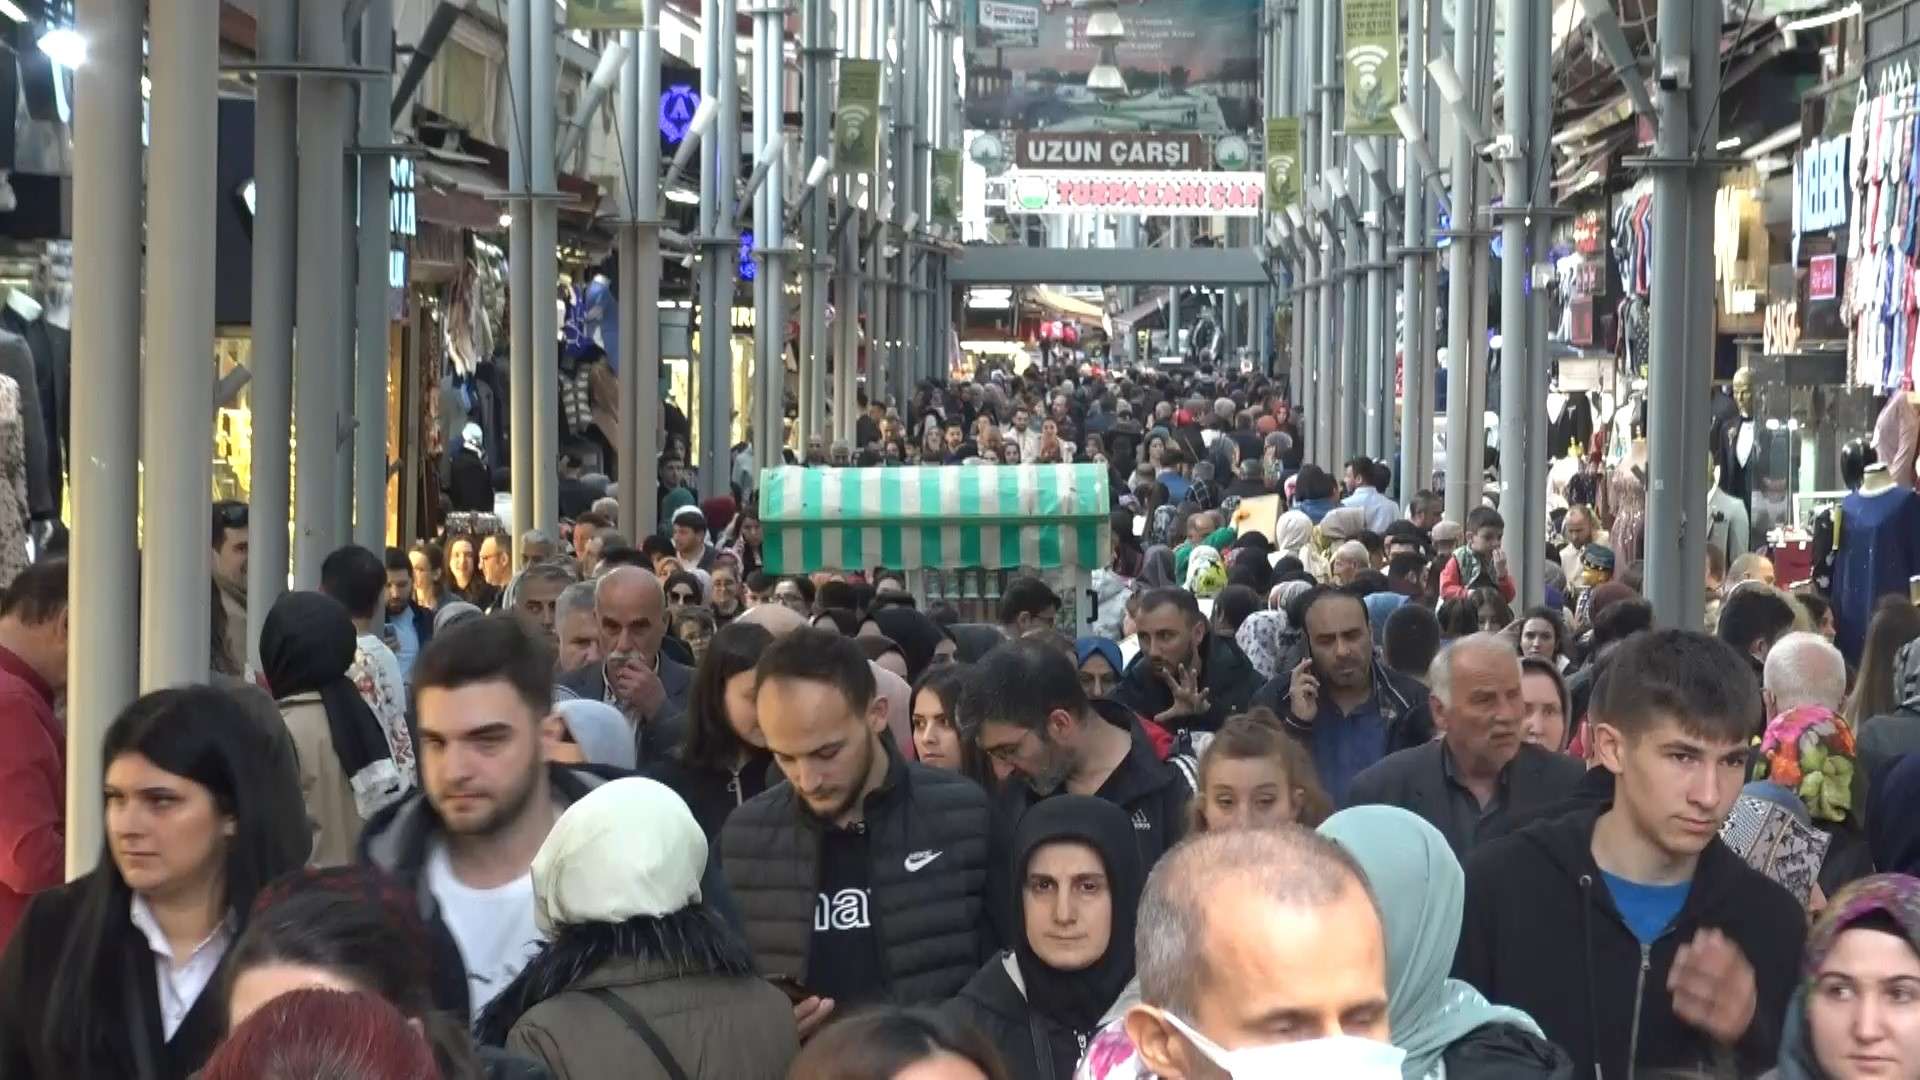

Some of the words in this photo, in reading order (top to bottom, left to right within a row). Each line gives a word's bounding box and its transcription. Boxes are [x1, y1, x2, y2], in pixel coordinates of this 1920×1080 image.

[1027, 140, 1102, 163] UZUN
[1109, 140, 1190, 167] ÇARŞI
[1209, 182, 1263, 210] ÇAR
